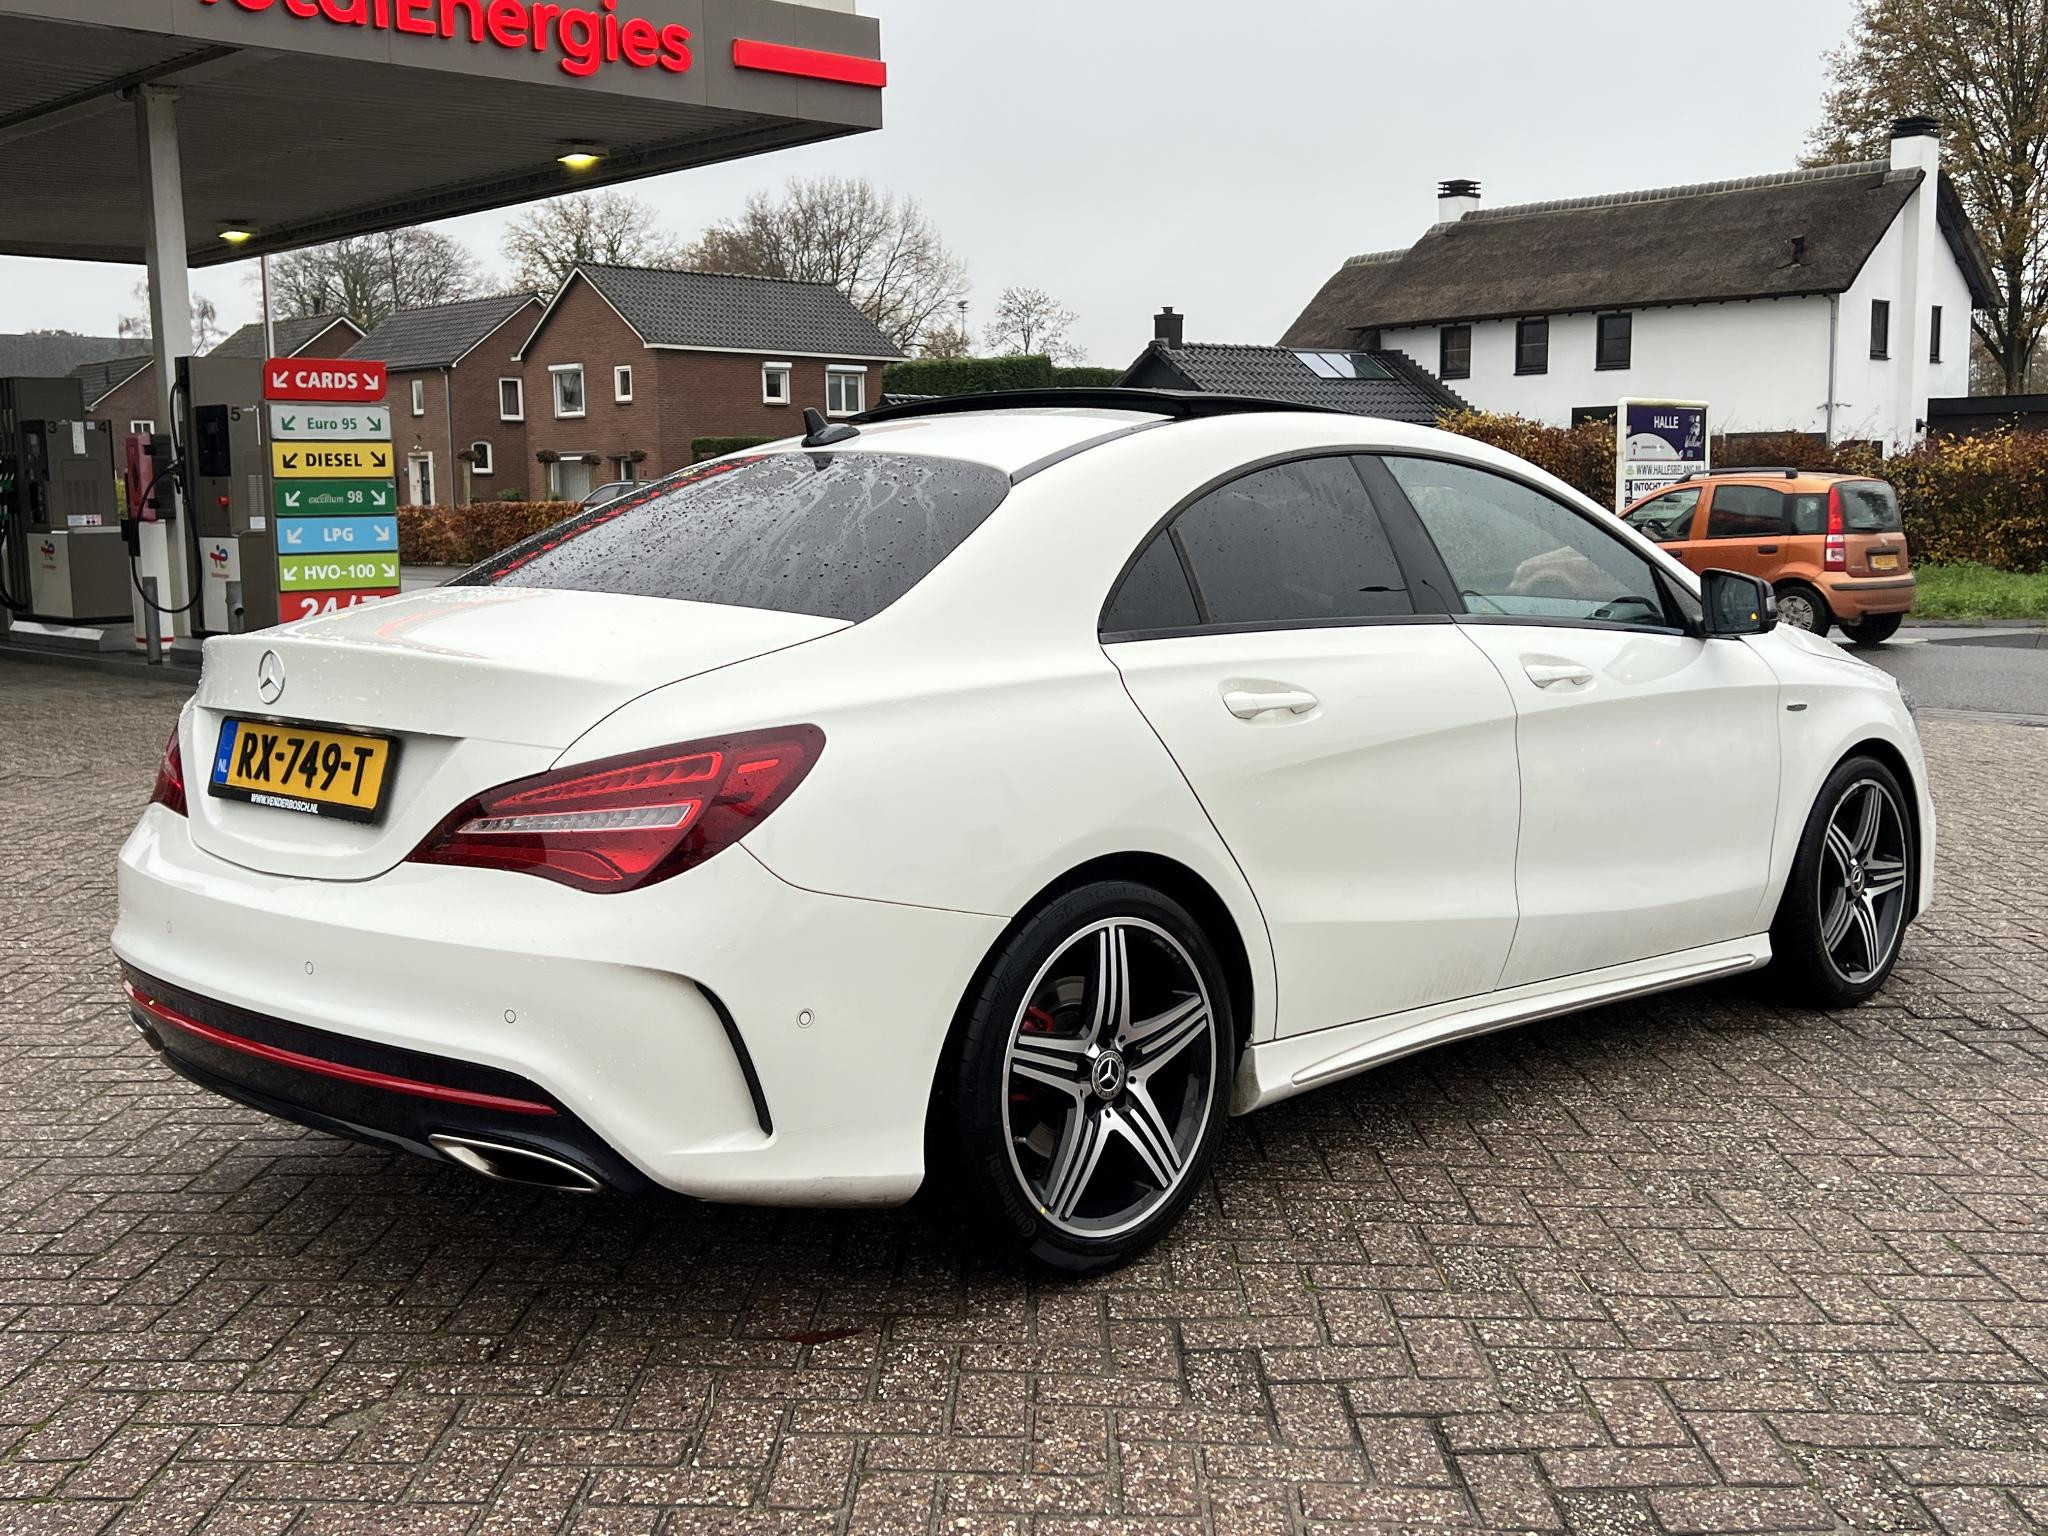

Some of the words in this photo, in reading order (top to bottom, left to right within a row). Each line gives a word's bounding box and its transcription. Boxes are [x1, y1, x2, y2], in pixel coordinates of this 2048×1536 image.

[197, 0, 693, 76] Energies
[295, 371, 358, 389] CARDS
[231, 407, 241, 421] 5
[48, 421, 57, 433] 3
[307, 417, 338, 430] Euro
[341, 417, 357, 430] 95
[1654, 416, 1679, 428] HALLE
[305, 453, 363, 467] DIESEL
[347, 490, 364, 503] 98
[323, 527, 353, 542] LPG
[304, 564, 375, 580] HVO-100
[301, 595, 381, 620] 24
[217, 759, 228, 773] NL
[236, 732, 374, 796] RX-749-T
